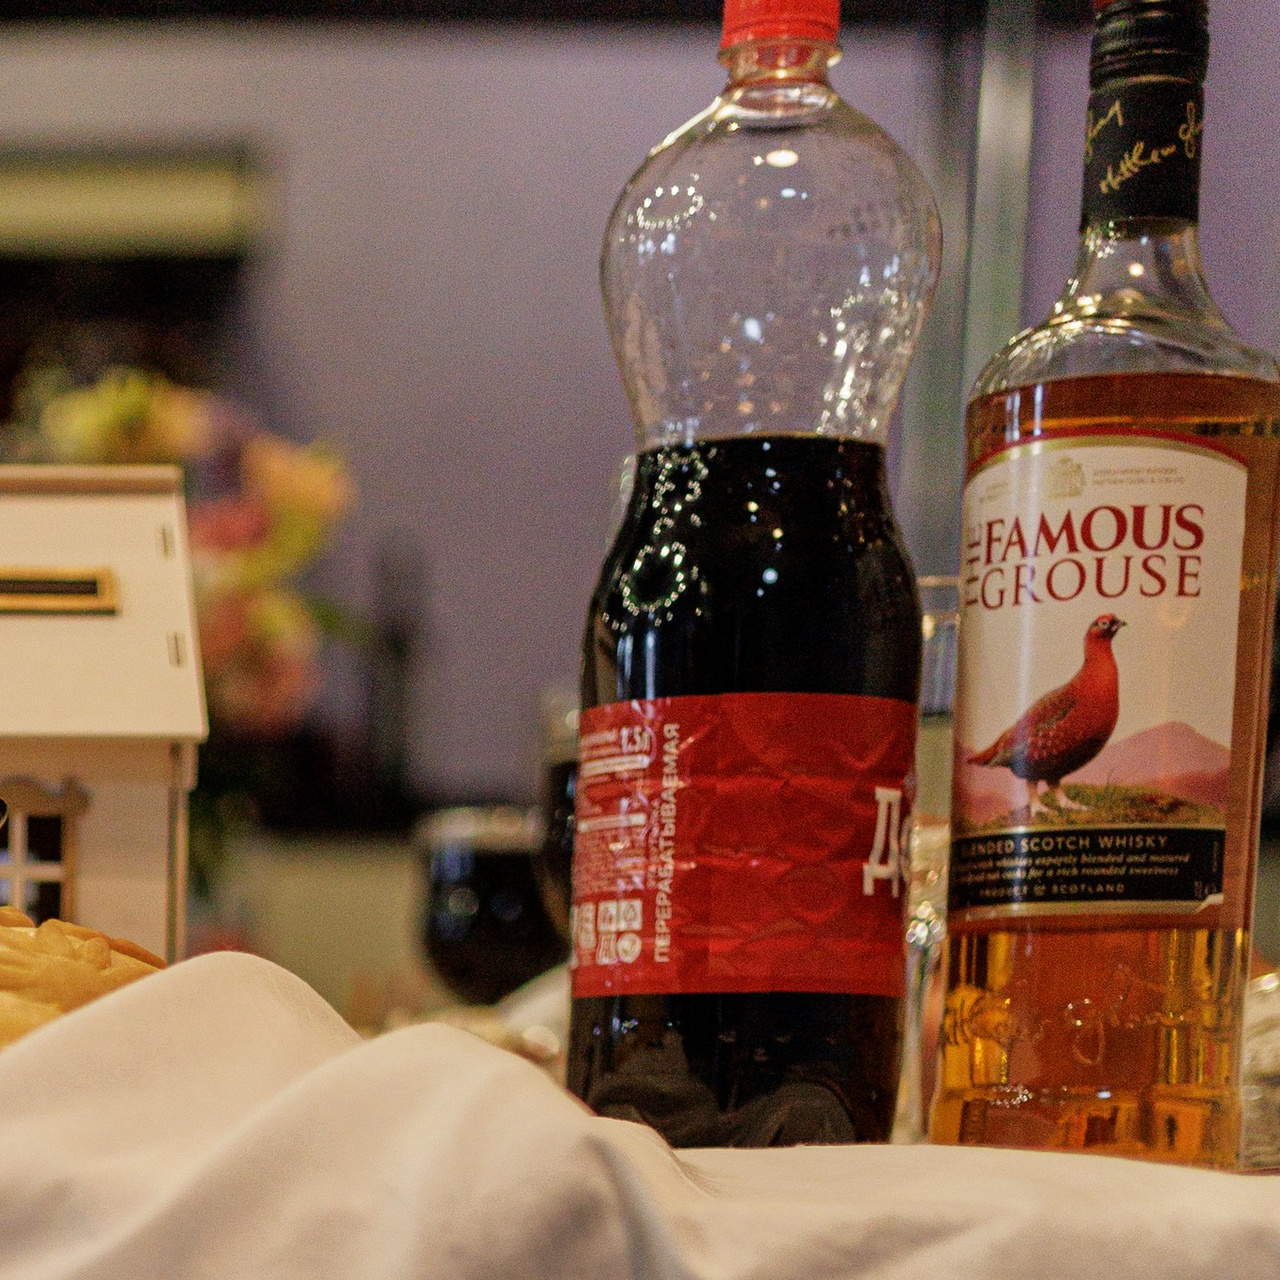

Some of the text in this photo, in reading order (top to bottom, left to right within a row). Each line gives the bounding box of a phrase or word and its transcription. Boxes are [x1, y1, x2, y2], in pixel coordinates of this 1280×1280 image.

[984, 503, 1205, 565] FAMOUS
[980, 553, 1202, 610] GROUSE
[654, 723, 680, 963] ПЕРЕРАБАТЫВАЕМАЯ
[1020, 836, 1090, 853] SCOTCH
[1099, 834, 1168, 849] WHISKY
